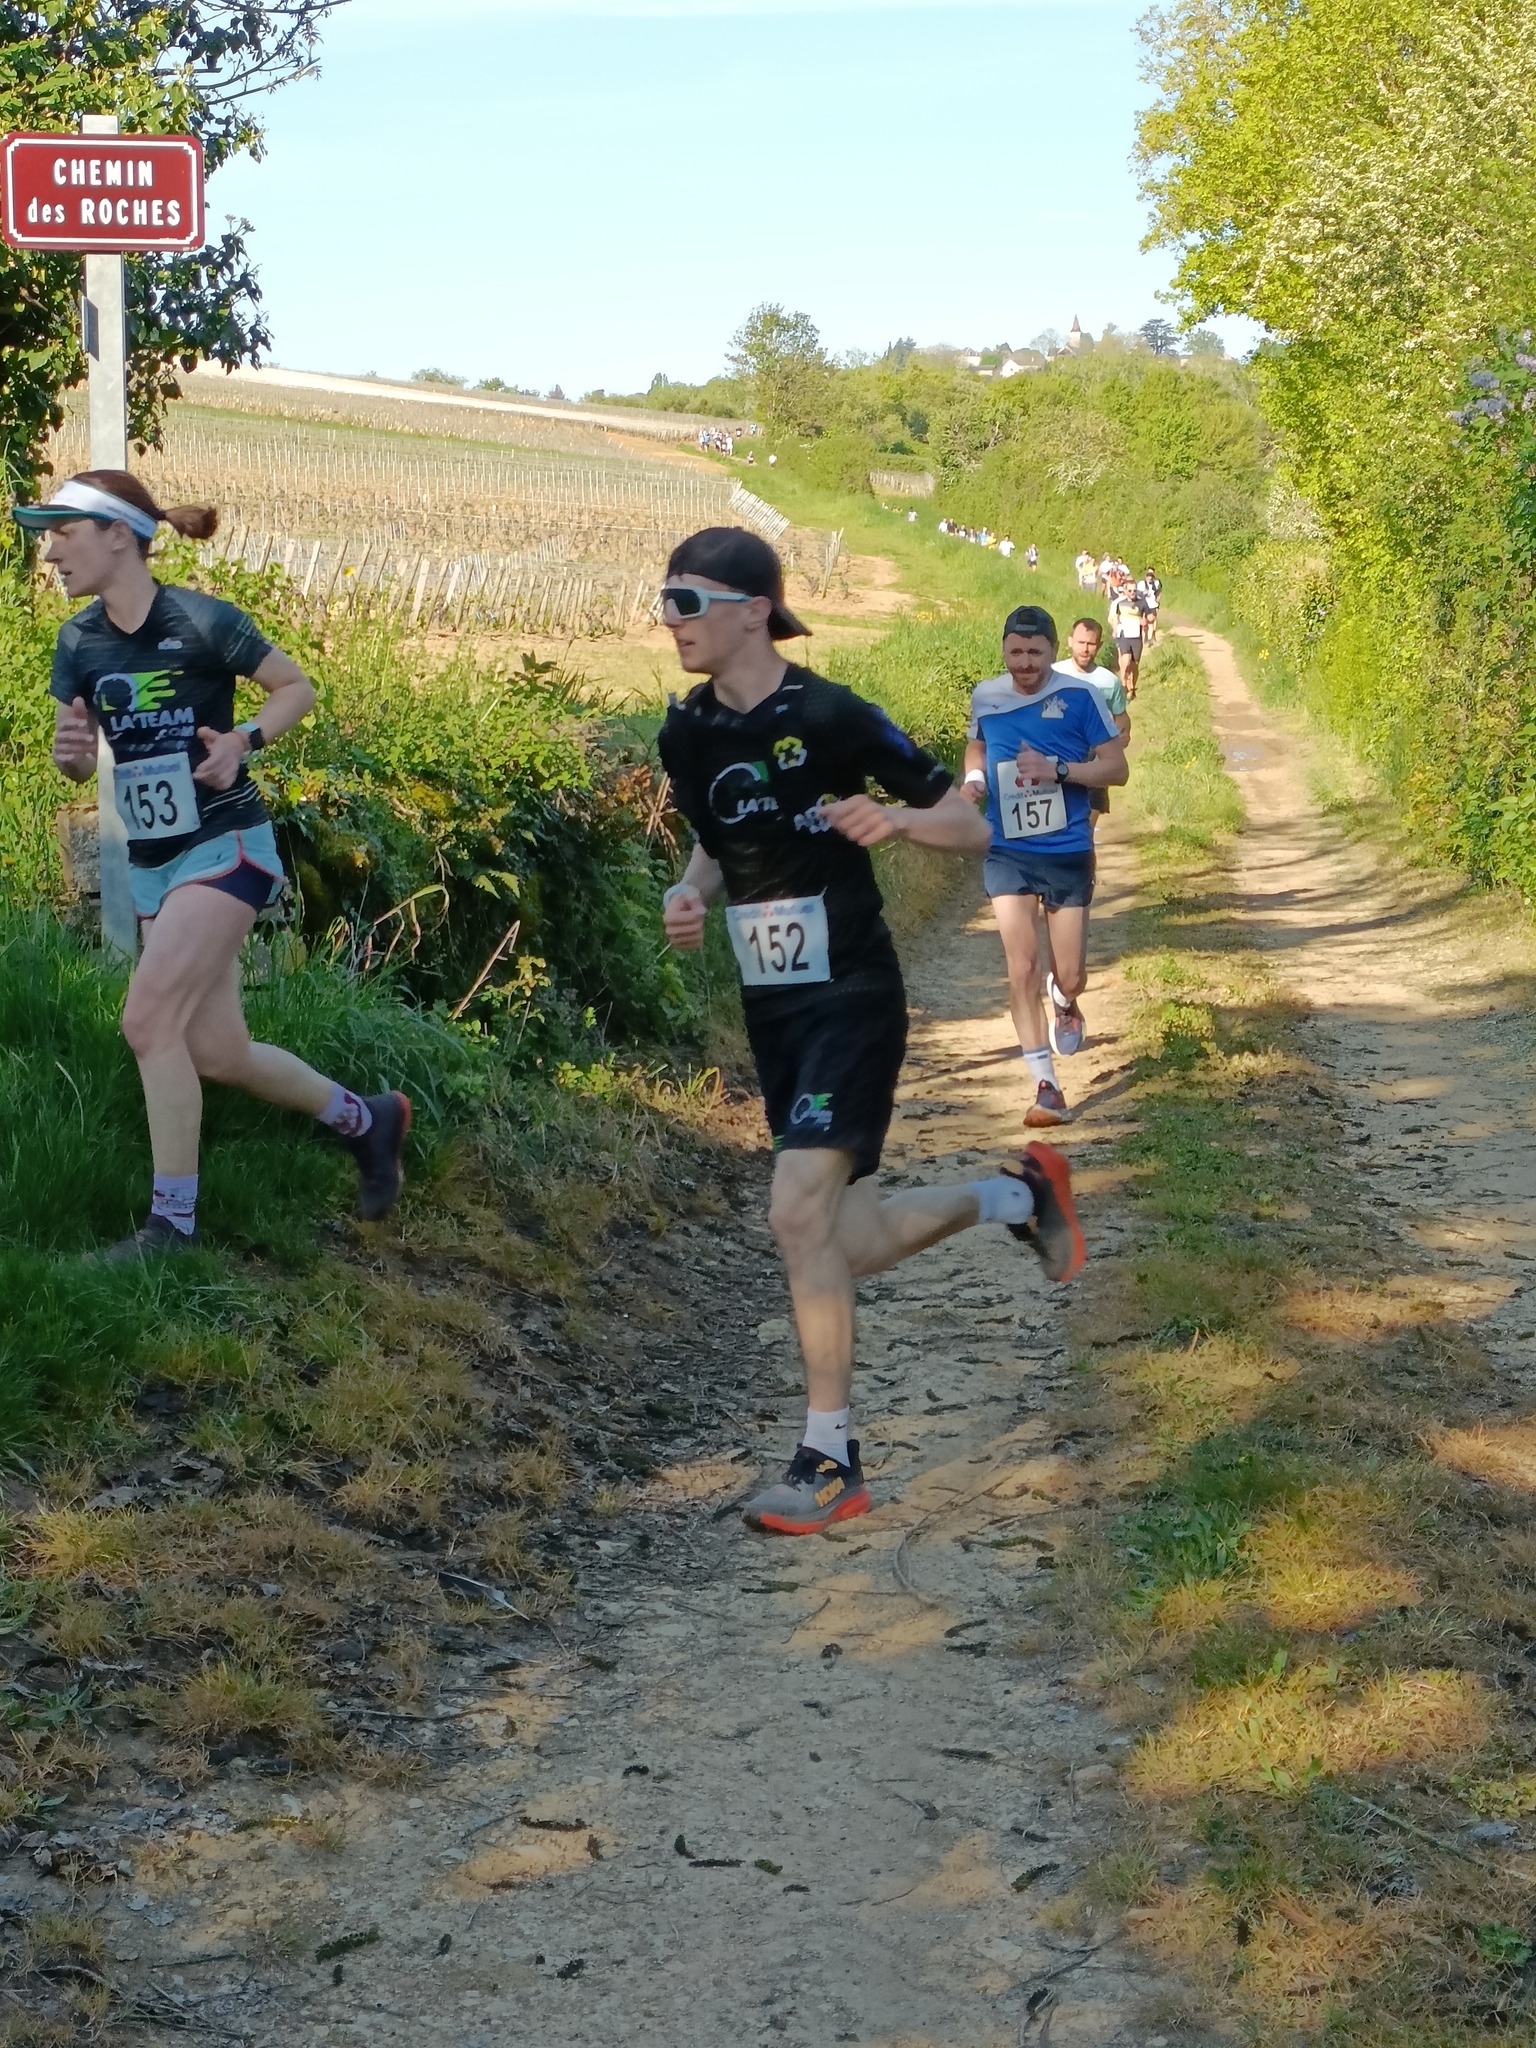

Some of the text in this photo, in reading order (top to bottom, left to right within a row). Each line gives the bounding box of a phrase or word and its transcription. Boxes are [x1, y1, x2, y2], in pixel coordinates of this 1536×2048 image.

[53, 158, 154, 187] CHEMIN
[27, 197, 182, 226] des ROCHES
[124, 780, 178, 830] 153
[1011, 798, 1052, 831] 157
[748, 922, 810, 974] 152
